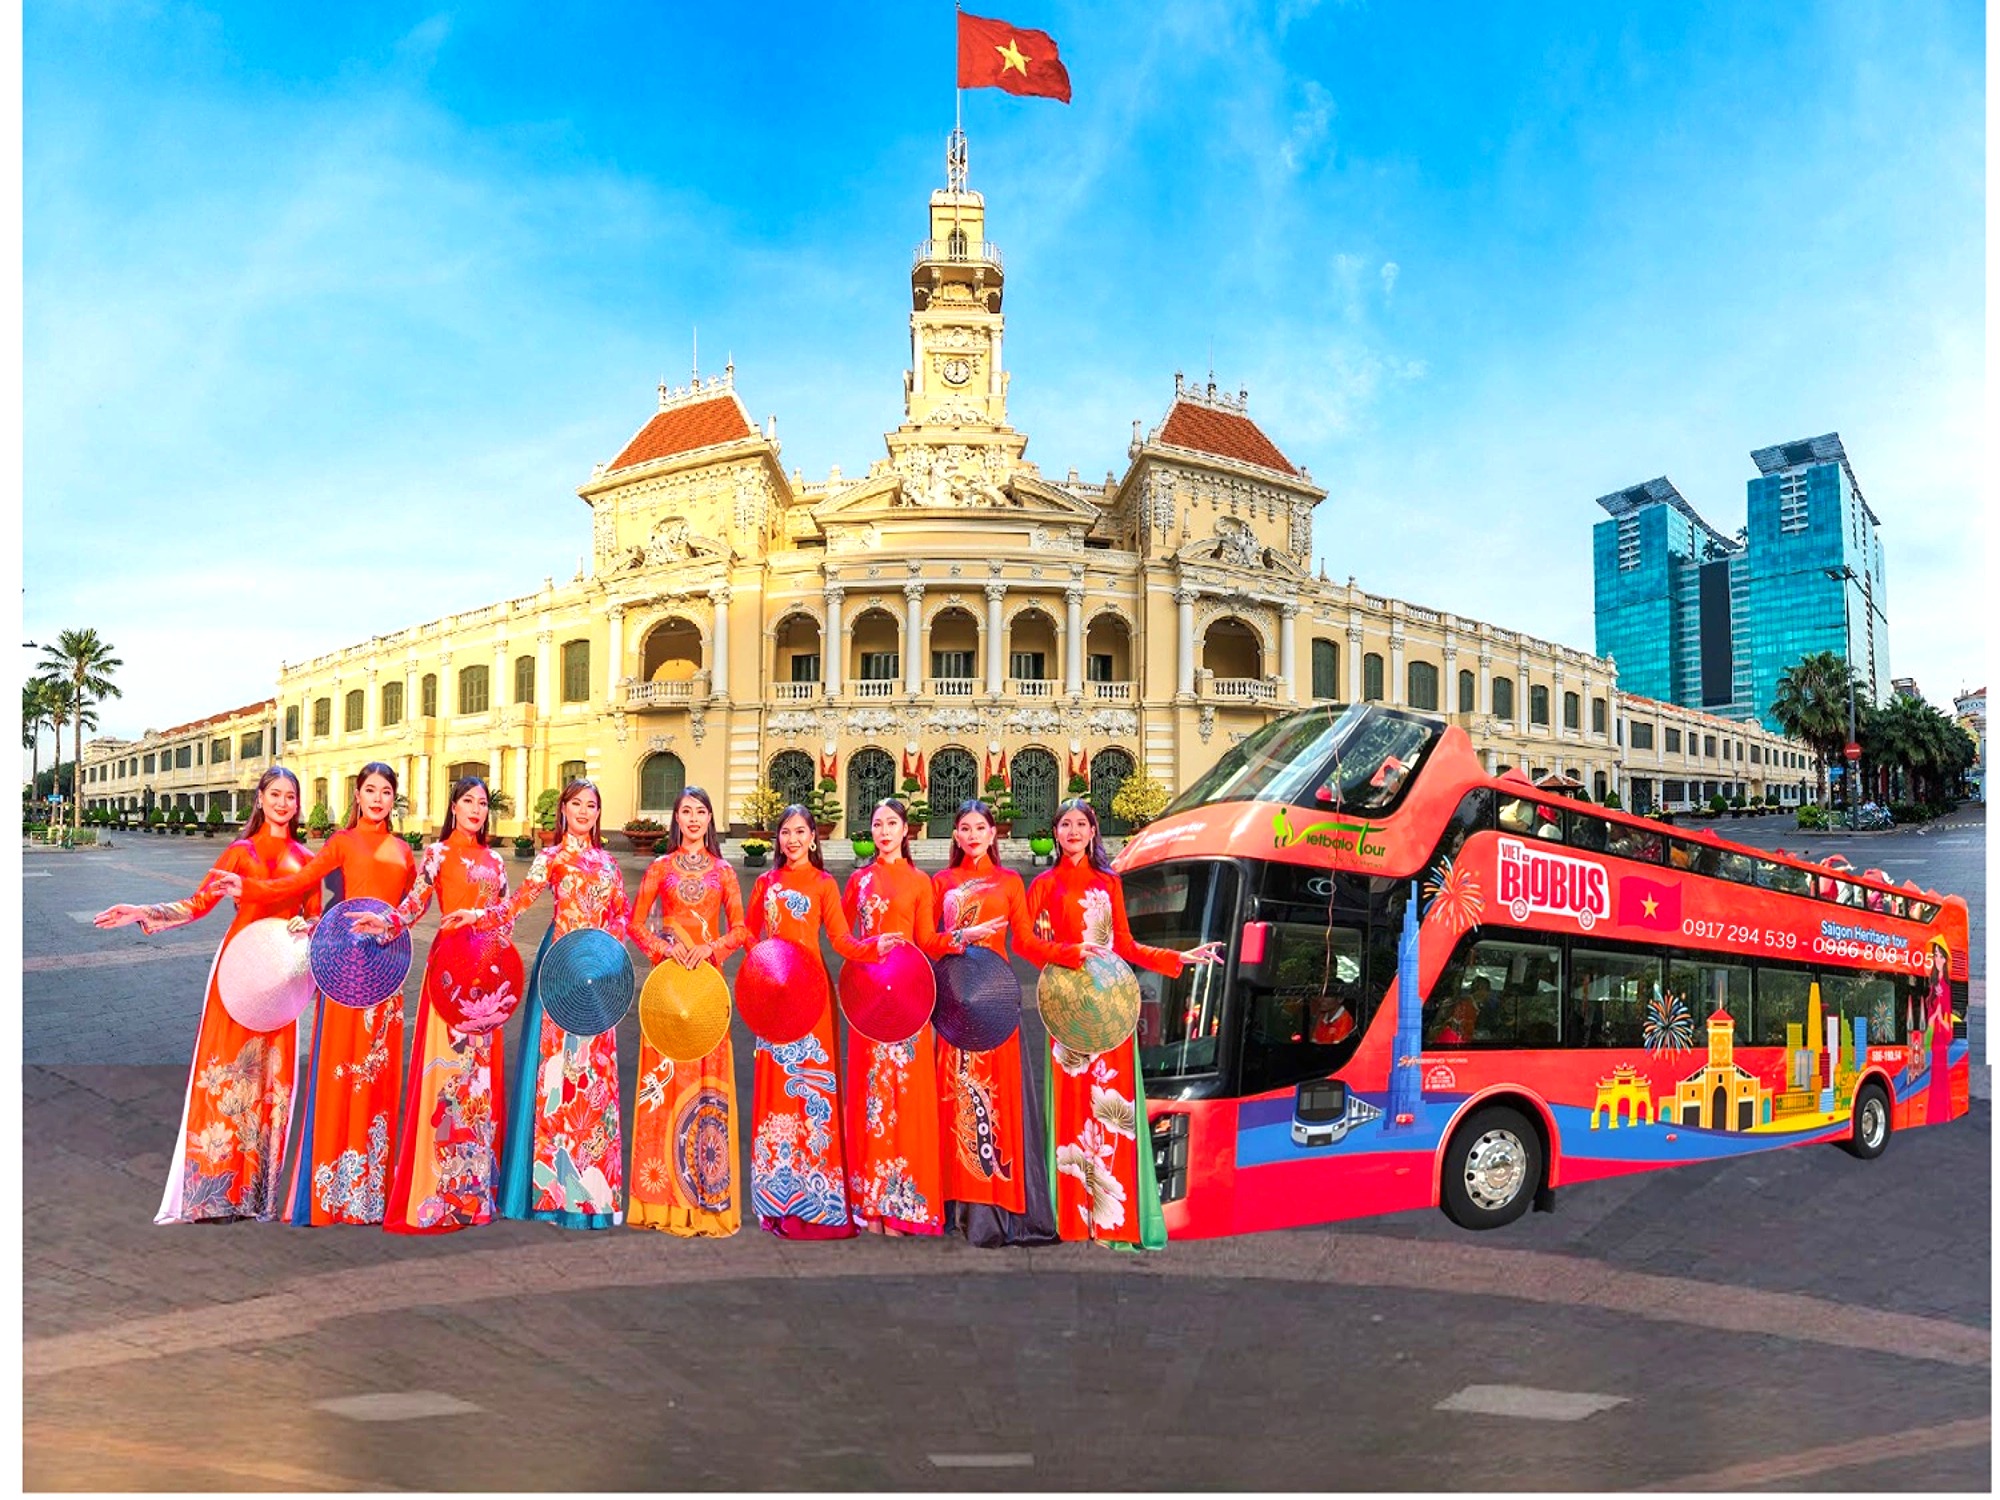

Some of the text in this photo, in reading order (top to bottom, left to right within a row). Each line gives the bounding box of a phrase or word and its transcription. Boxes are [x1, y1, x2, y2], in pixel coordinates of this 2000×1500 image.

[1356, 821, 1387, 857] Tour
[1501, 843, 1521, 861] VIET
[1682, 918, 1725, 940] 0917
[1727, 924, 1760, 945] 294
[1764, 929, 1797, 950] 539
[1812, 937, 1859, 958] 0986
[1863, 944, 1897, 964] 808
[1902, 950, 1935, 969] 105
[1821, 919, 1909, 949] Saigon Heritage tour
